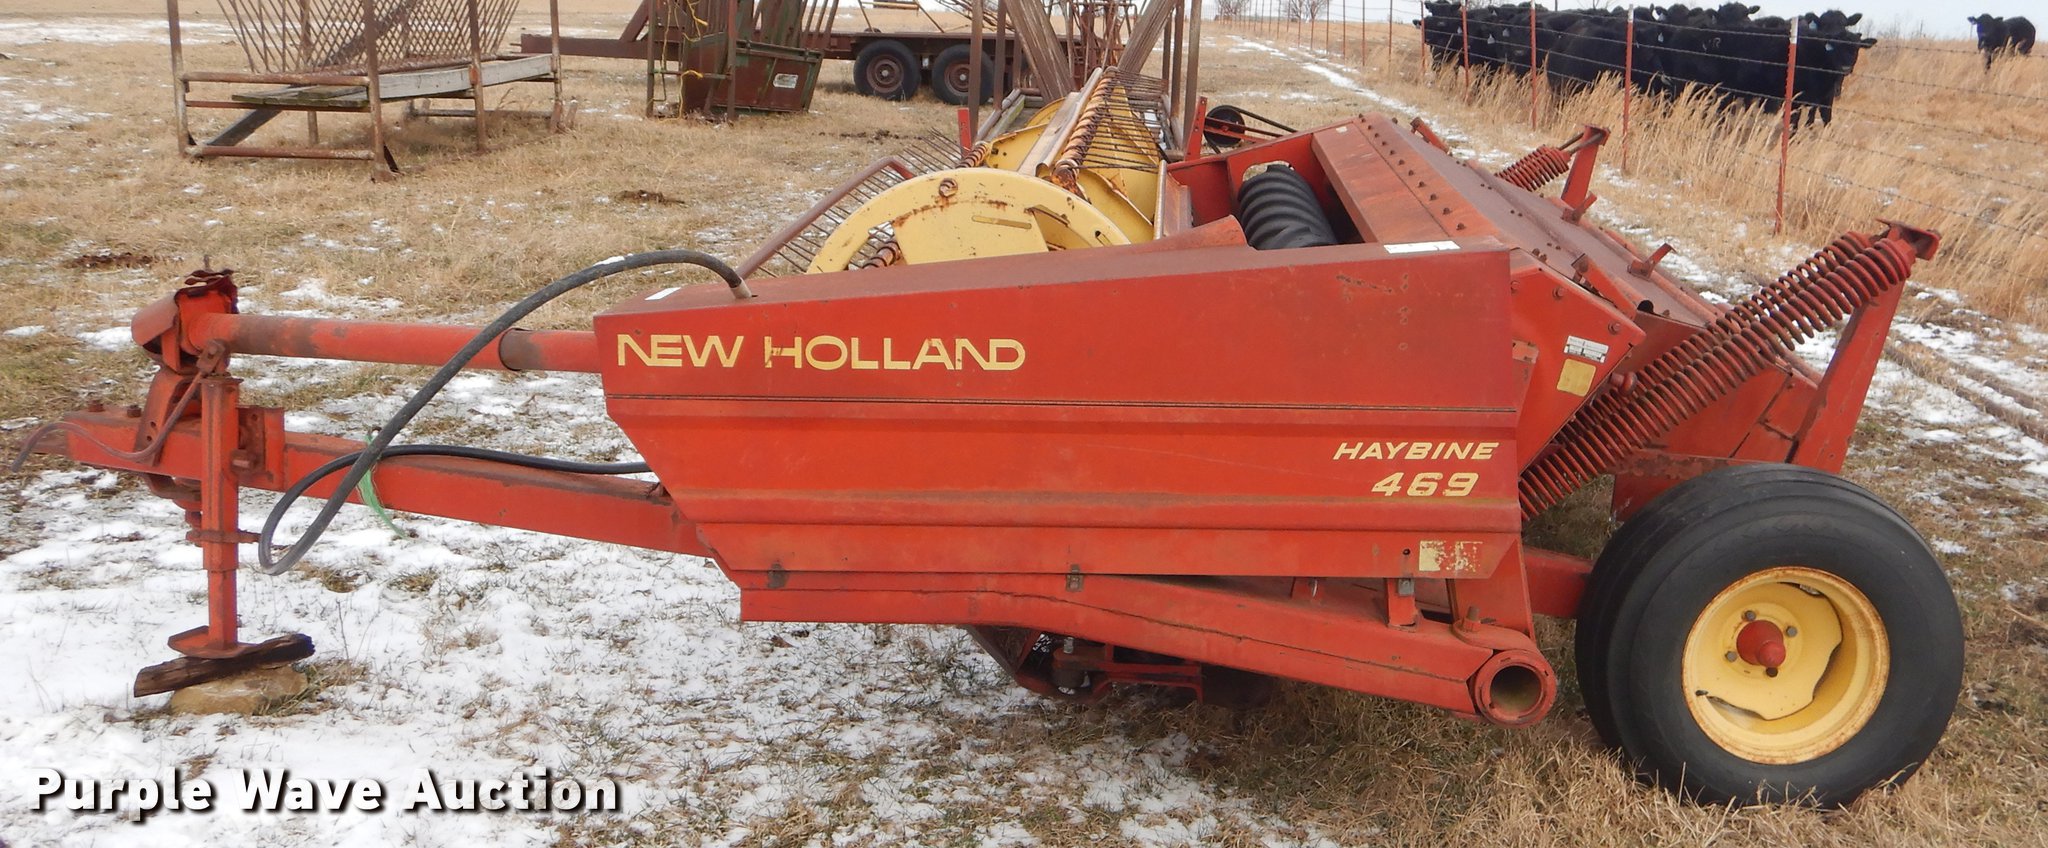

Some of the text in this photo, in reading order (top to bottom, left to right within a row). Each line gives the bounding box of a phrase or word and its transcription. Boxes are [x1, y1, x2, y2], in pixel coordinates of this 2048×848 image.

[617, 334, 1025, 371] NEW HOLLAND
[1332, 441, 1500, 460] HAYBINE
[1371, 471, 1479, 497] 469
